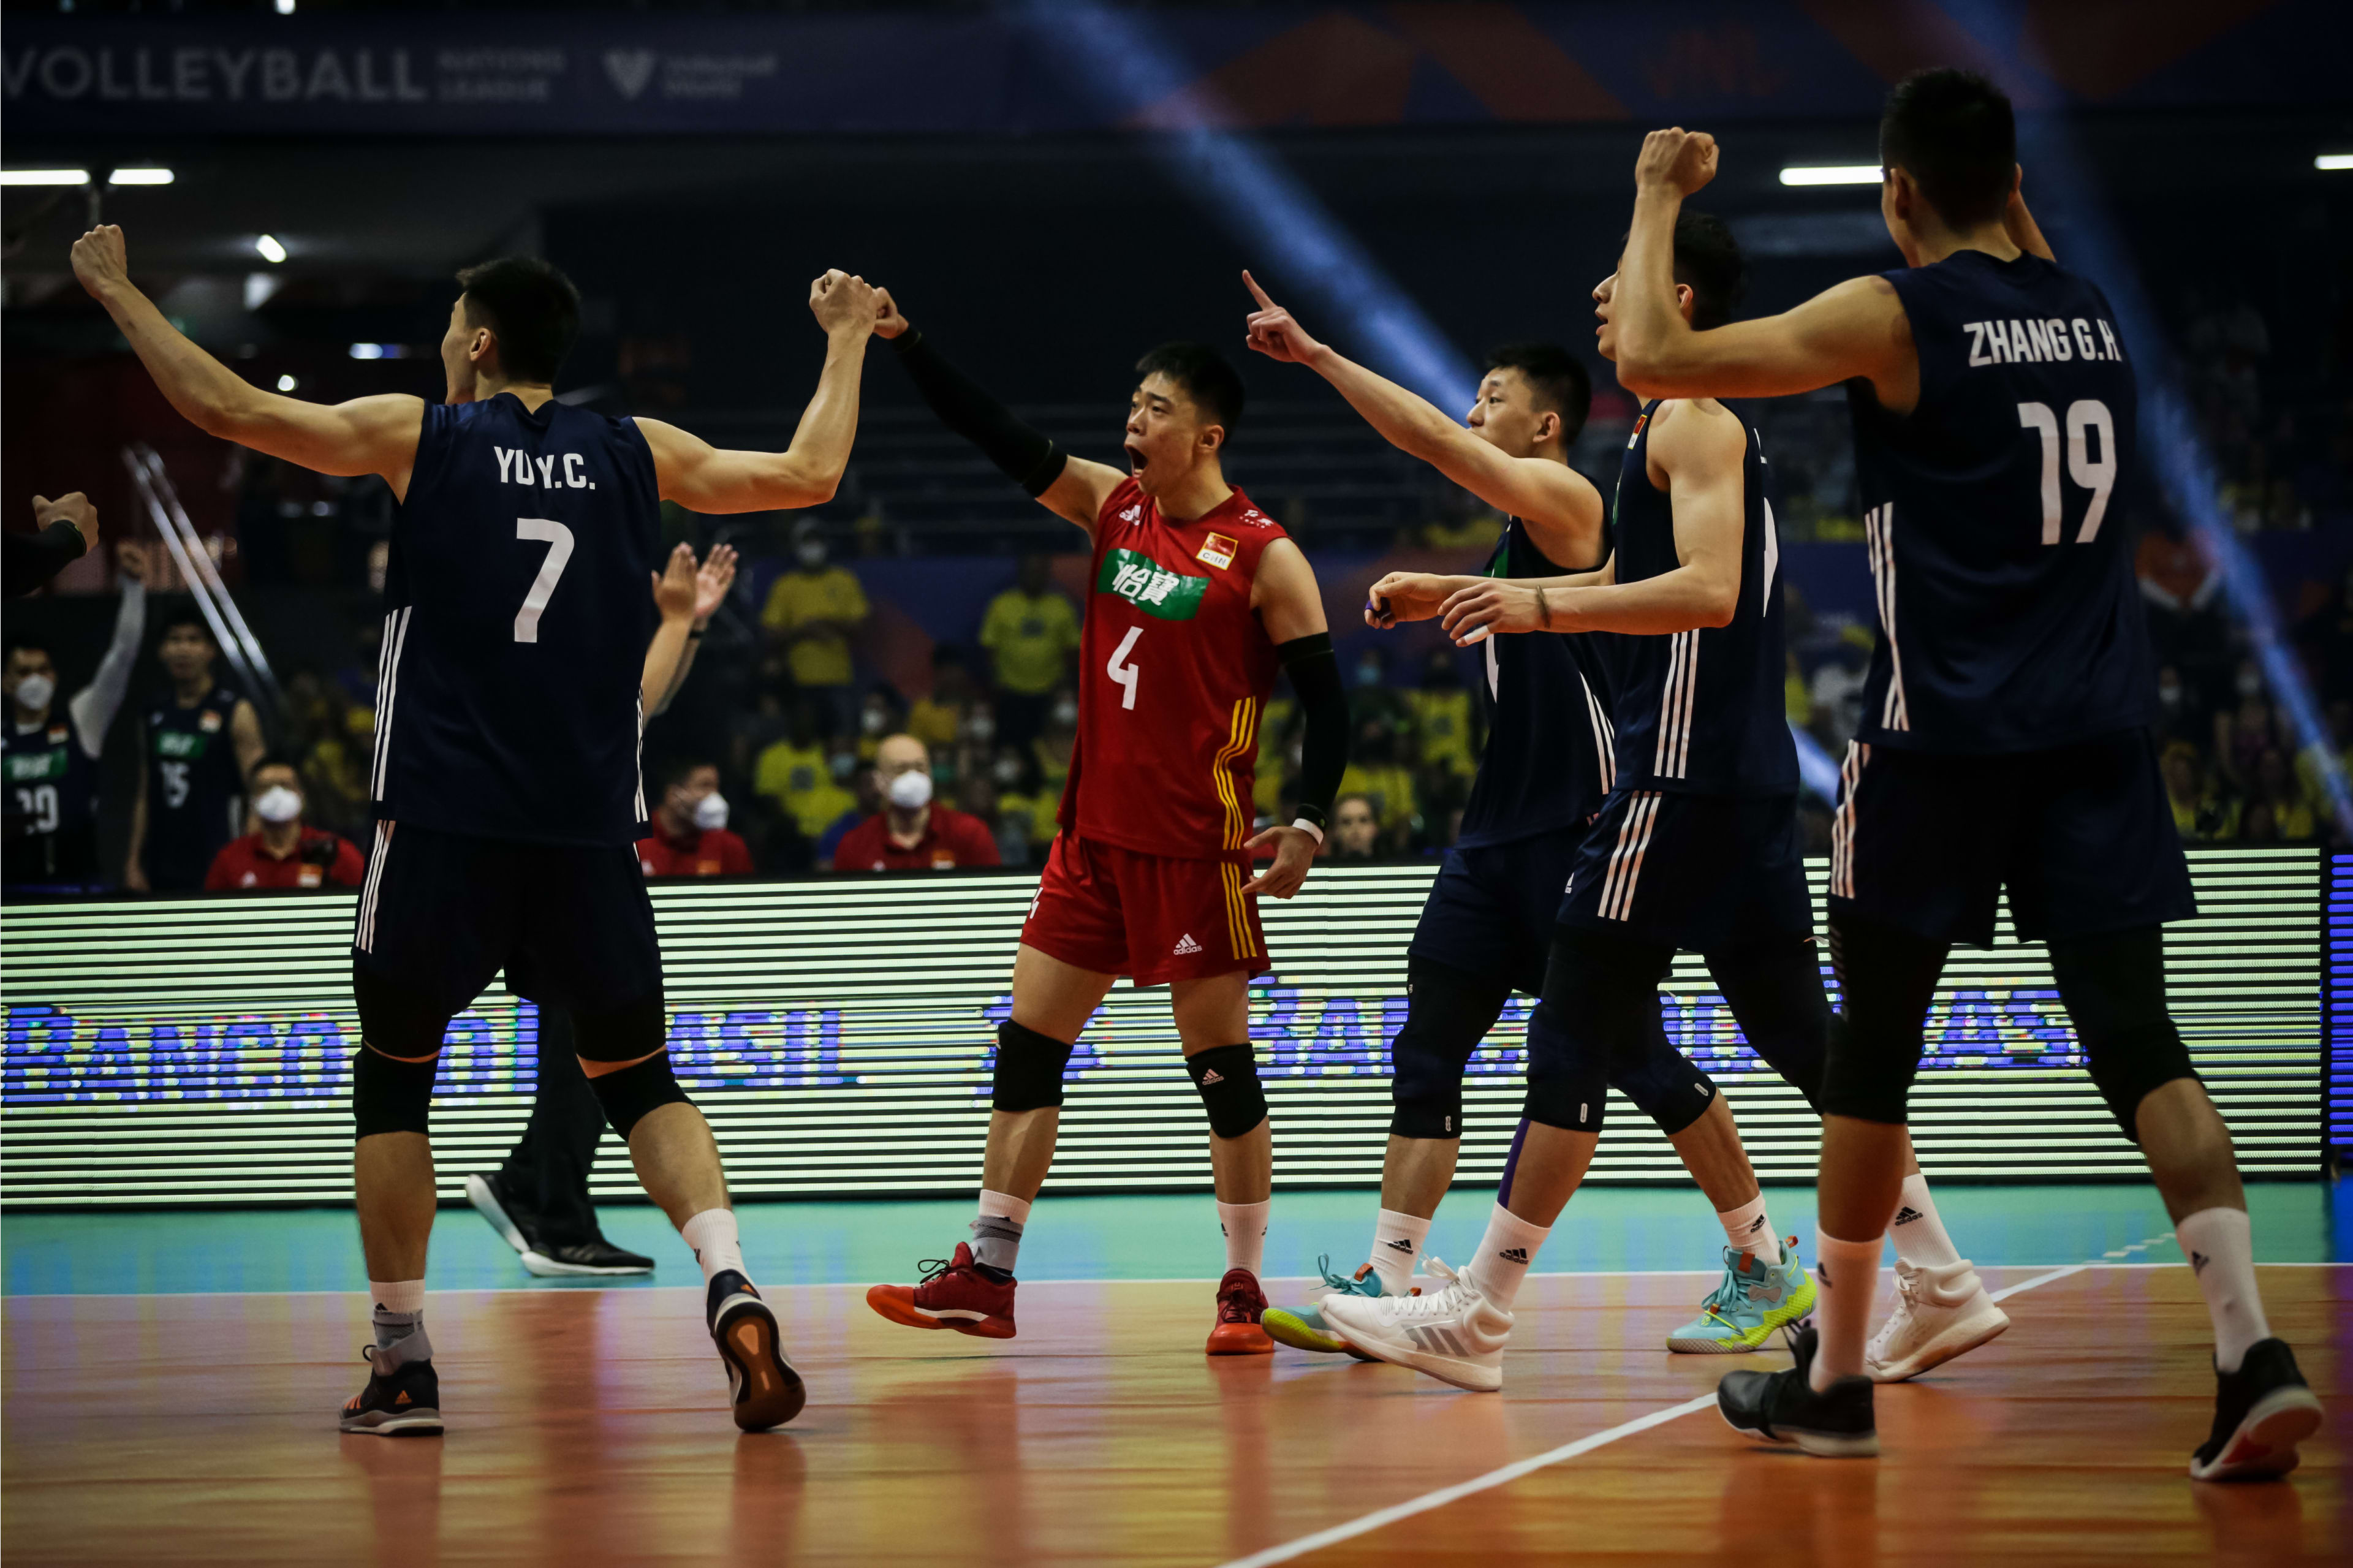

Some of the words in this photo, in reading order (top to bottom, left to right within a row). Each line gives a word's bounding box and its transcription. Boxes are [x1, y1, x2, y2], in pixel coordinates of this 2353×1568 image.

[1, 45, 426, 102] VOLLEYBALL
[1963, 319, 2072, 367] ZHANG
[2017, 399, 2117, 545] 19
[514, 518, 575, 642] 7
[1107, 626, 1144, 711] 4
[1173, 945, 1202, 955] adidas
[2, 1003, 345, 1108] BANCO
[1202, 1076, 1224, 1085] adidas
[1895, 1212, 1923, 1225] adidas
[1387, 1243, 1414, 1255] adidas
[1499, 1252, 1529, 1265] adidas
